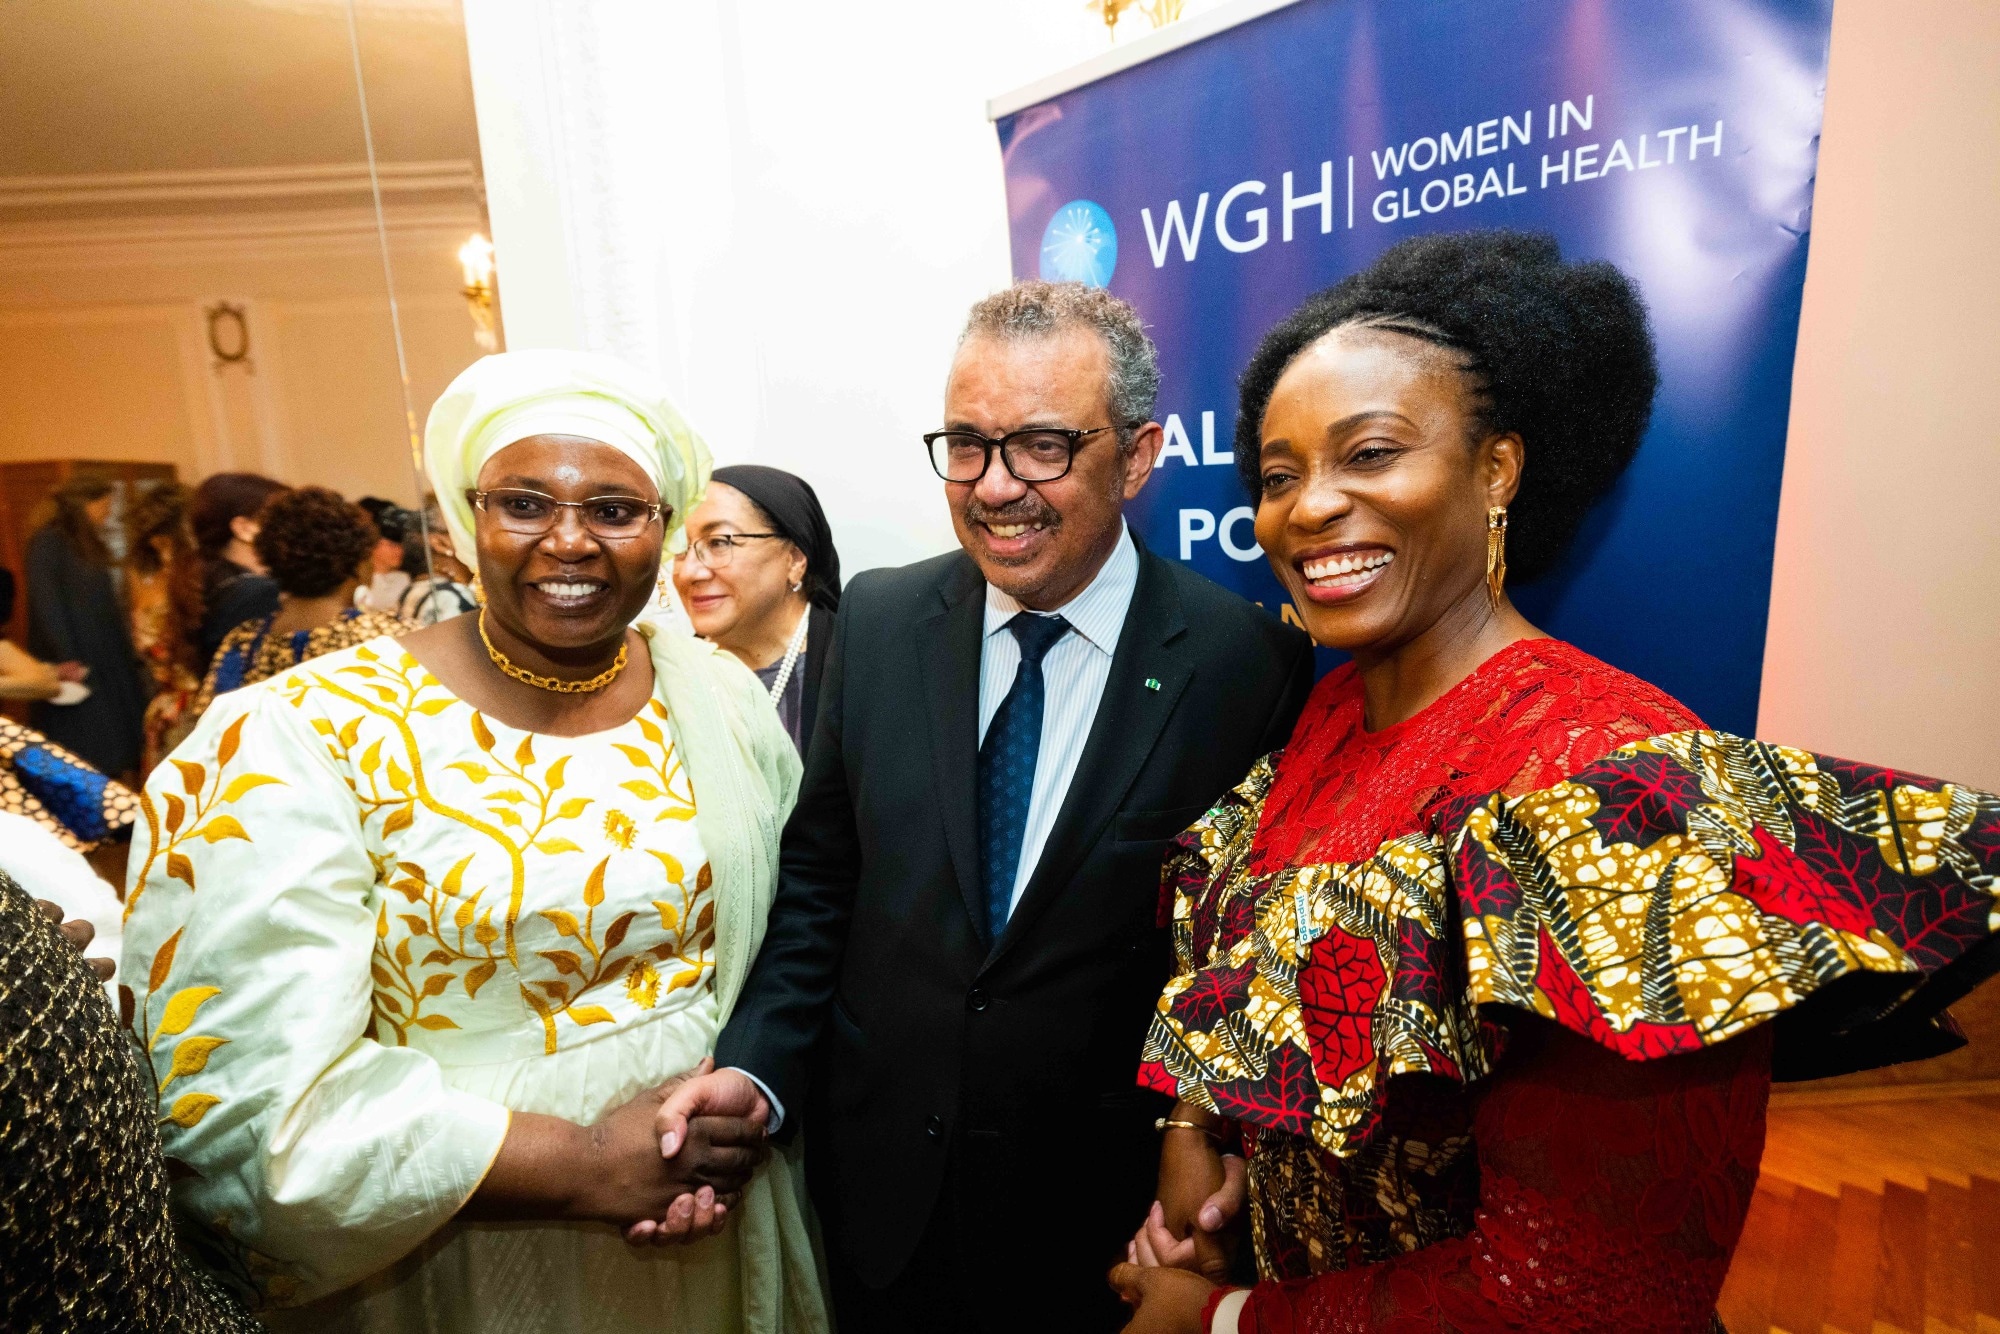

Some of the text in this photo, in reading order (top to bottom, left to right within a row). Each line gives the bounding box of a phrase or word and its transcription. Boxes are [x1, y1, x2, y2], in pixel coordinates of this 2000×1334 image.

[1371, 94, 1594, 180] WOMEN IN
[1372, 119, 1723, 224] GLOBAL HEALTH
[1141, 161, 1332, 268] WGH
[1295, 894, 1308, 942] jhpiego
